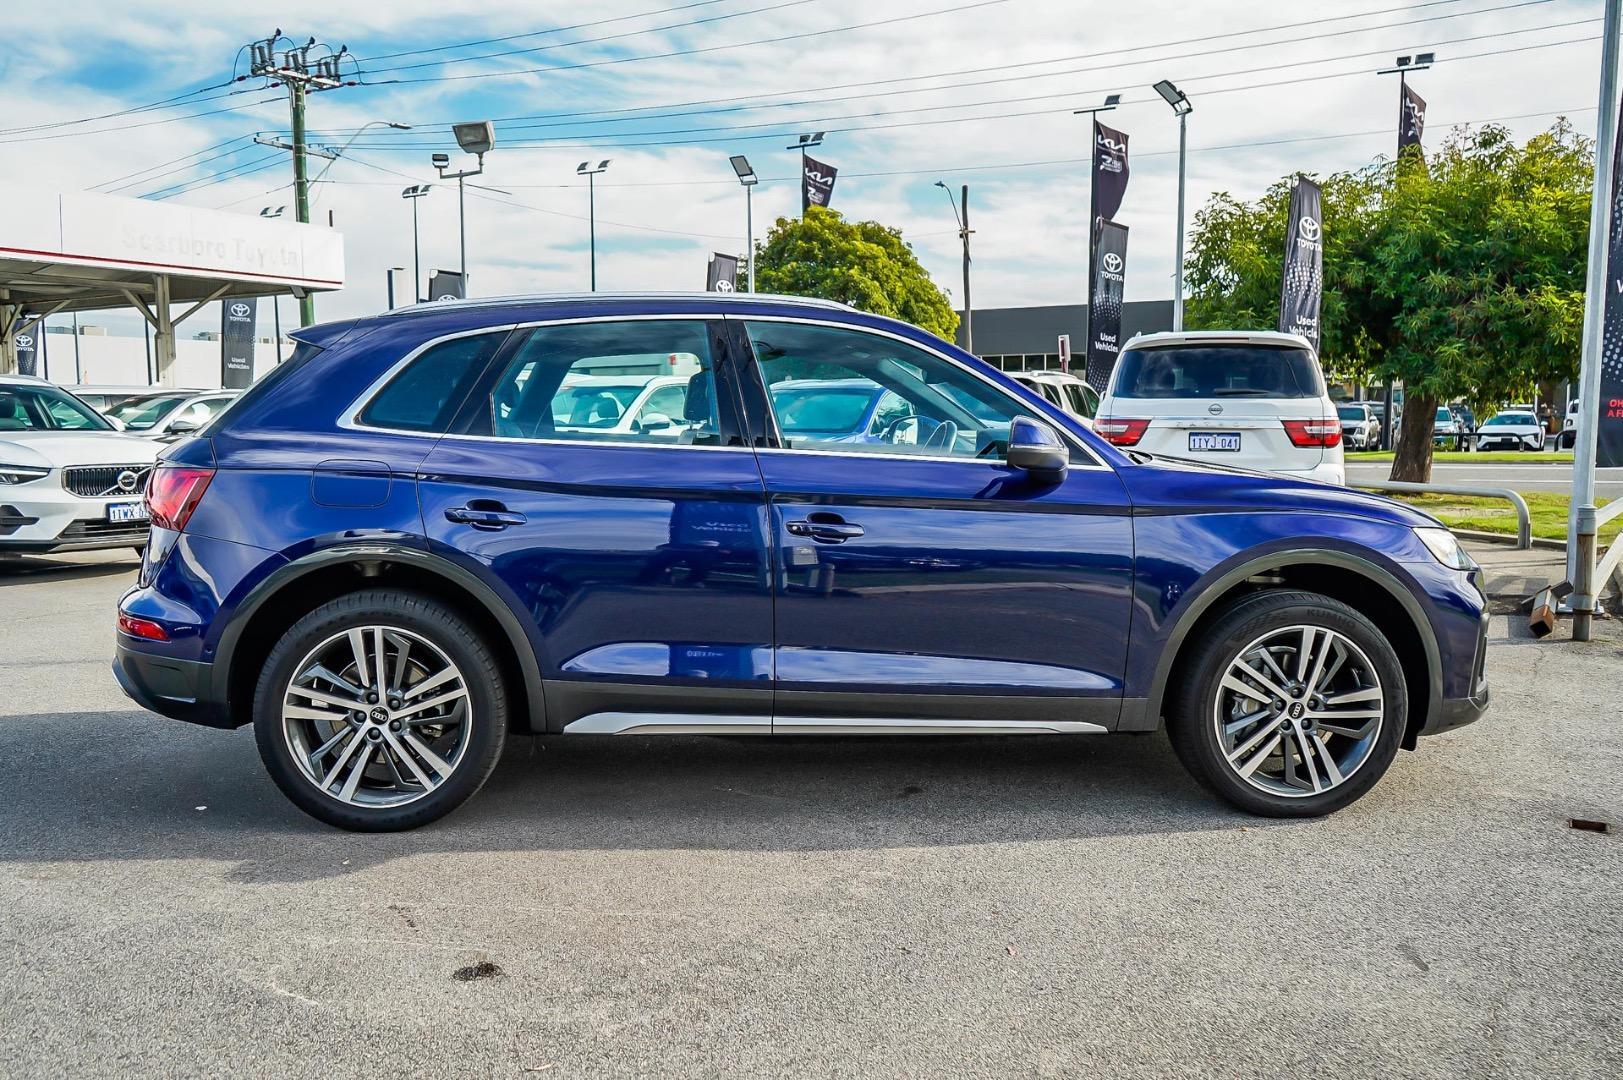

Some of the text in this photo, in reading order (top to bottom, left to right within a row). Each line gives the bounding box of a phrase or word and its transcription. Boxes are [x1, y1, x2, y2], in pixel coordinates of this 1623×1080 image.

[1297, 238, 1323, 252] TOYOTA
[1101, 271, 1124, 282] TOYOTA
[1296, 314, 1318, 327] Used
[1100, 332, 1117, 343] Used
[1095, 341, 1119, 353] Vehicles
[227, 362, 250, 370] Vehicles
